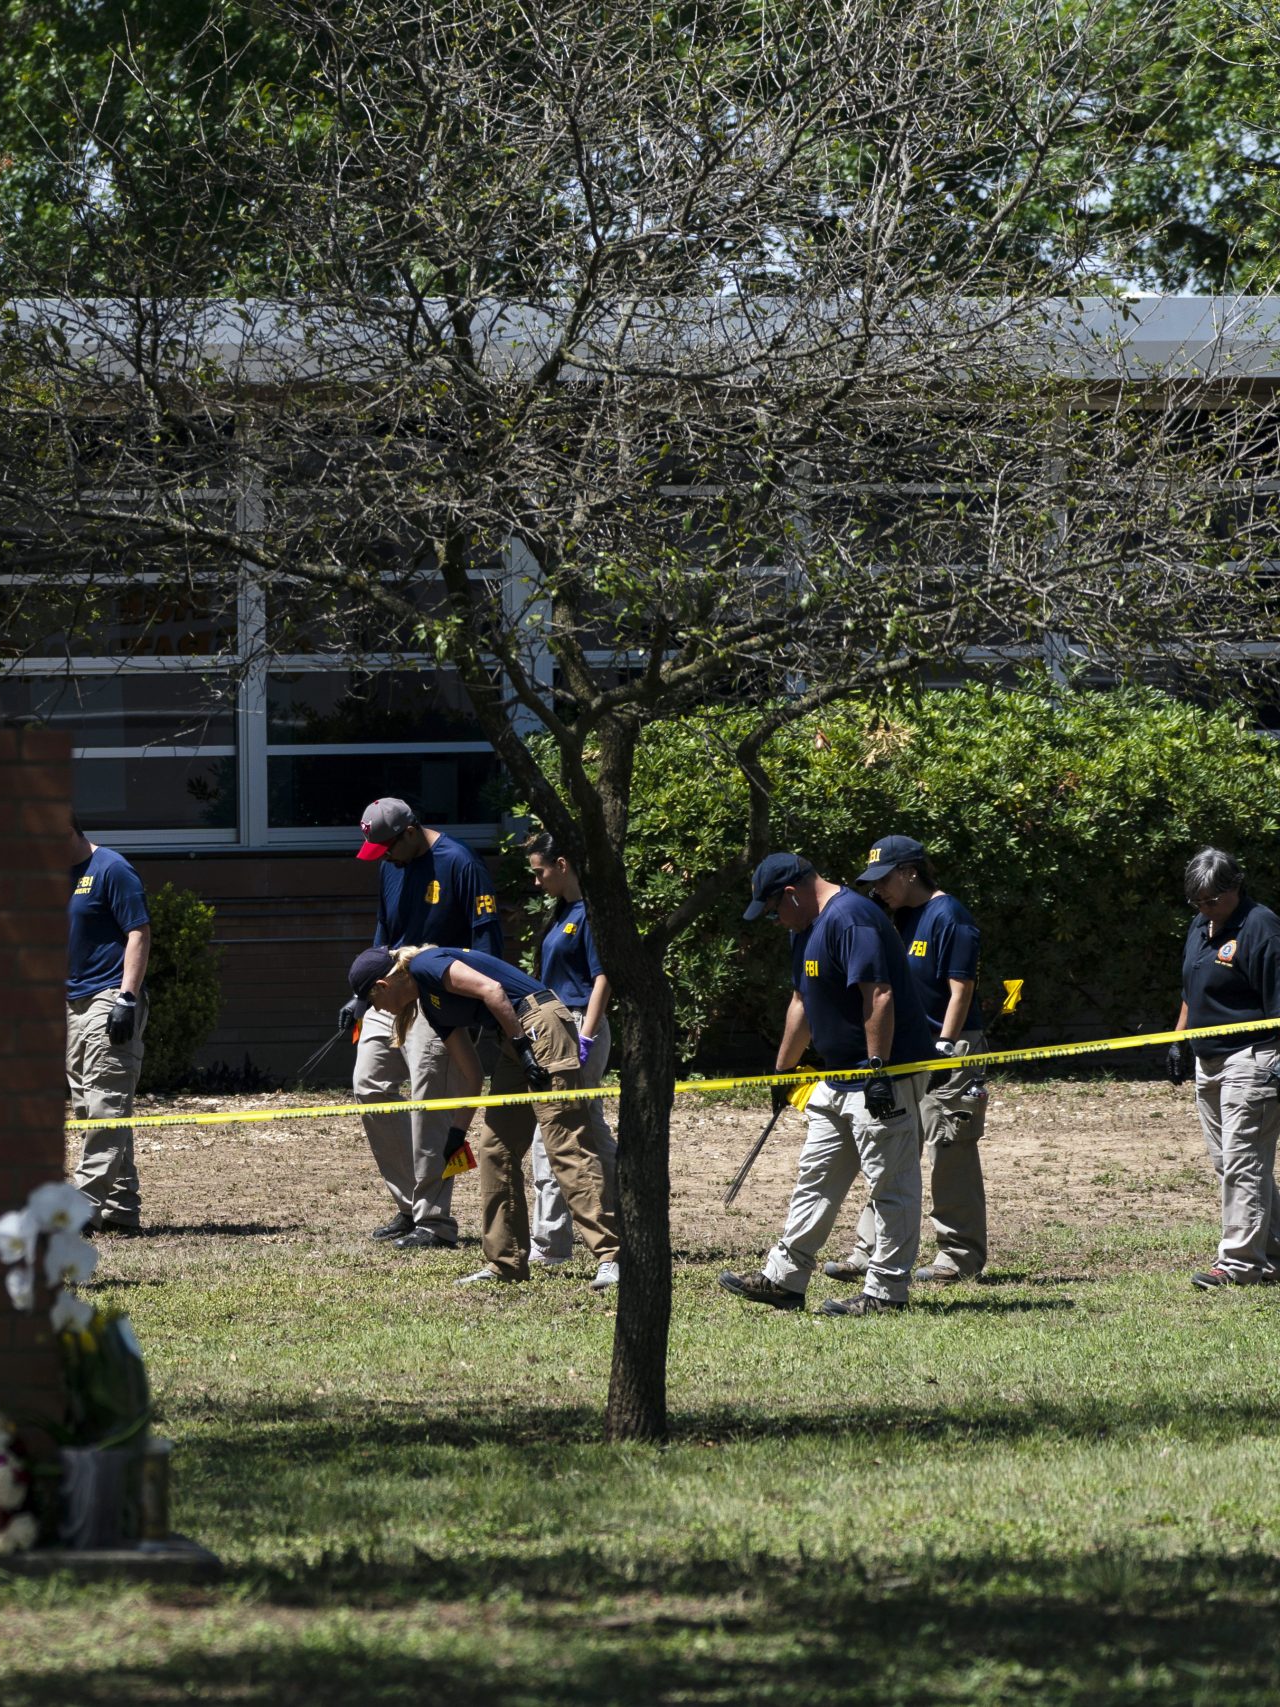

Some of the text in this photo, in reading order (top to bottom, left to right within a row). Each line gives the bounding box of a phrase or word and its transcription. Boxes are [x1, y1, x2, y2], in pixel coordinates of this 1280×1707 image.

[869, 849, 881, 863] BI
[908, 941, 927, 956] FBI
[805, 960, 819, 977] FBI
